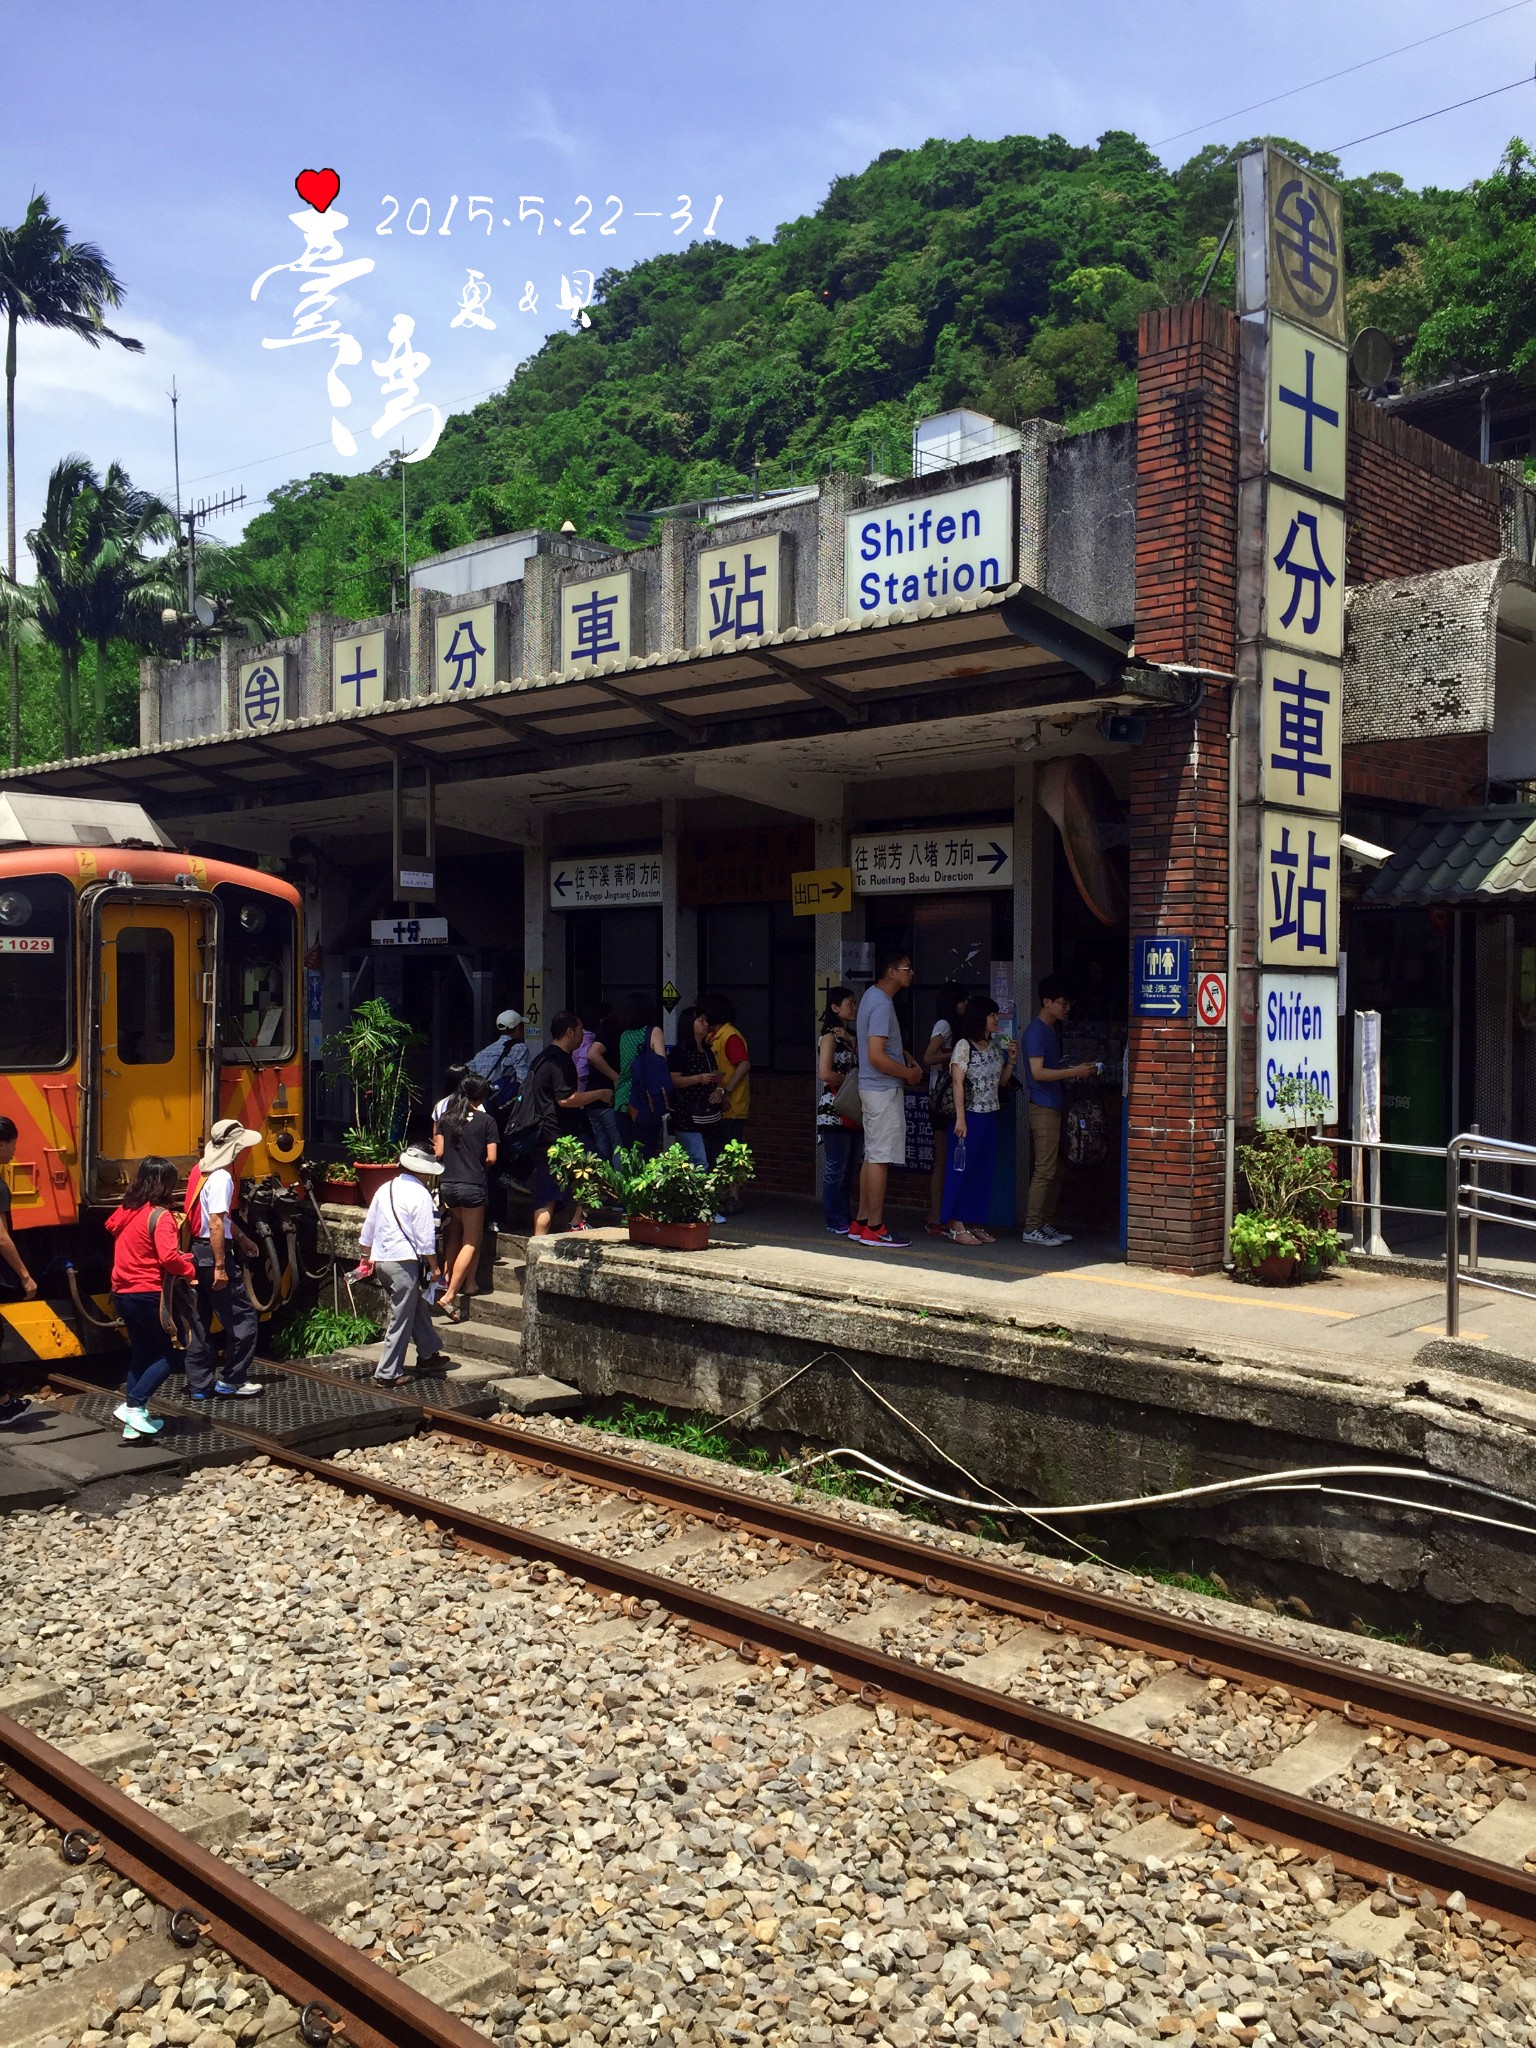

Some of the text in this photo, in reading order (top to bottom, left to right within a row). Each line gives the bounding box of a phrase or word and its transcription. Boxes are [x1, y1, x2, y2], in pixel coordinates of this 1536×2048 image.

[860, 509, 981, 562] Shifen
[859, 556, 1000, 611] Station
[340, 553, 768, 707] 十分車站
[1270, 349, 1339, 955] 十分車站
[855, 838, 974, 872] 往 瑞芳 八堵 方向
[575, 861, 661, 889] 往 平溪 菁桐 方向
[856, 871, 974, 886] To Rueifang Badu Direction
[575, 891, 584, 901] To
[632, 888, 661, 898] Direction
[794, 882, 821, 906] 出口
[8, 939, 51, 951] 1029
[392, 920, 421, 943] 十分
[420, 936, 448, 945] STATION
[527, 976, 541, 1024] 十分
[1140, 984, 1182, 993] 盥洗室
[1266, 990, 1322, 1042] Shifen
